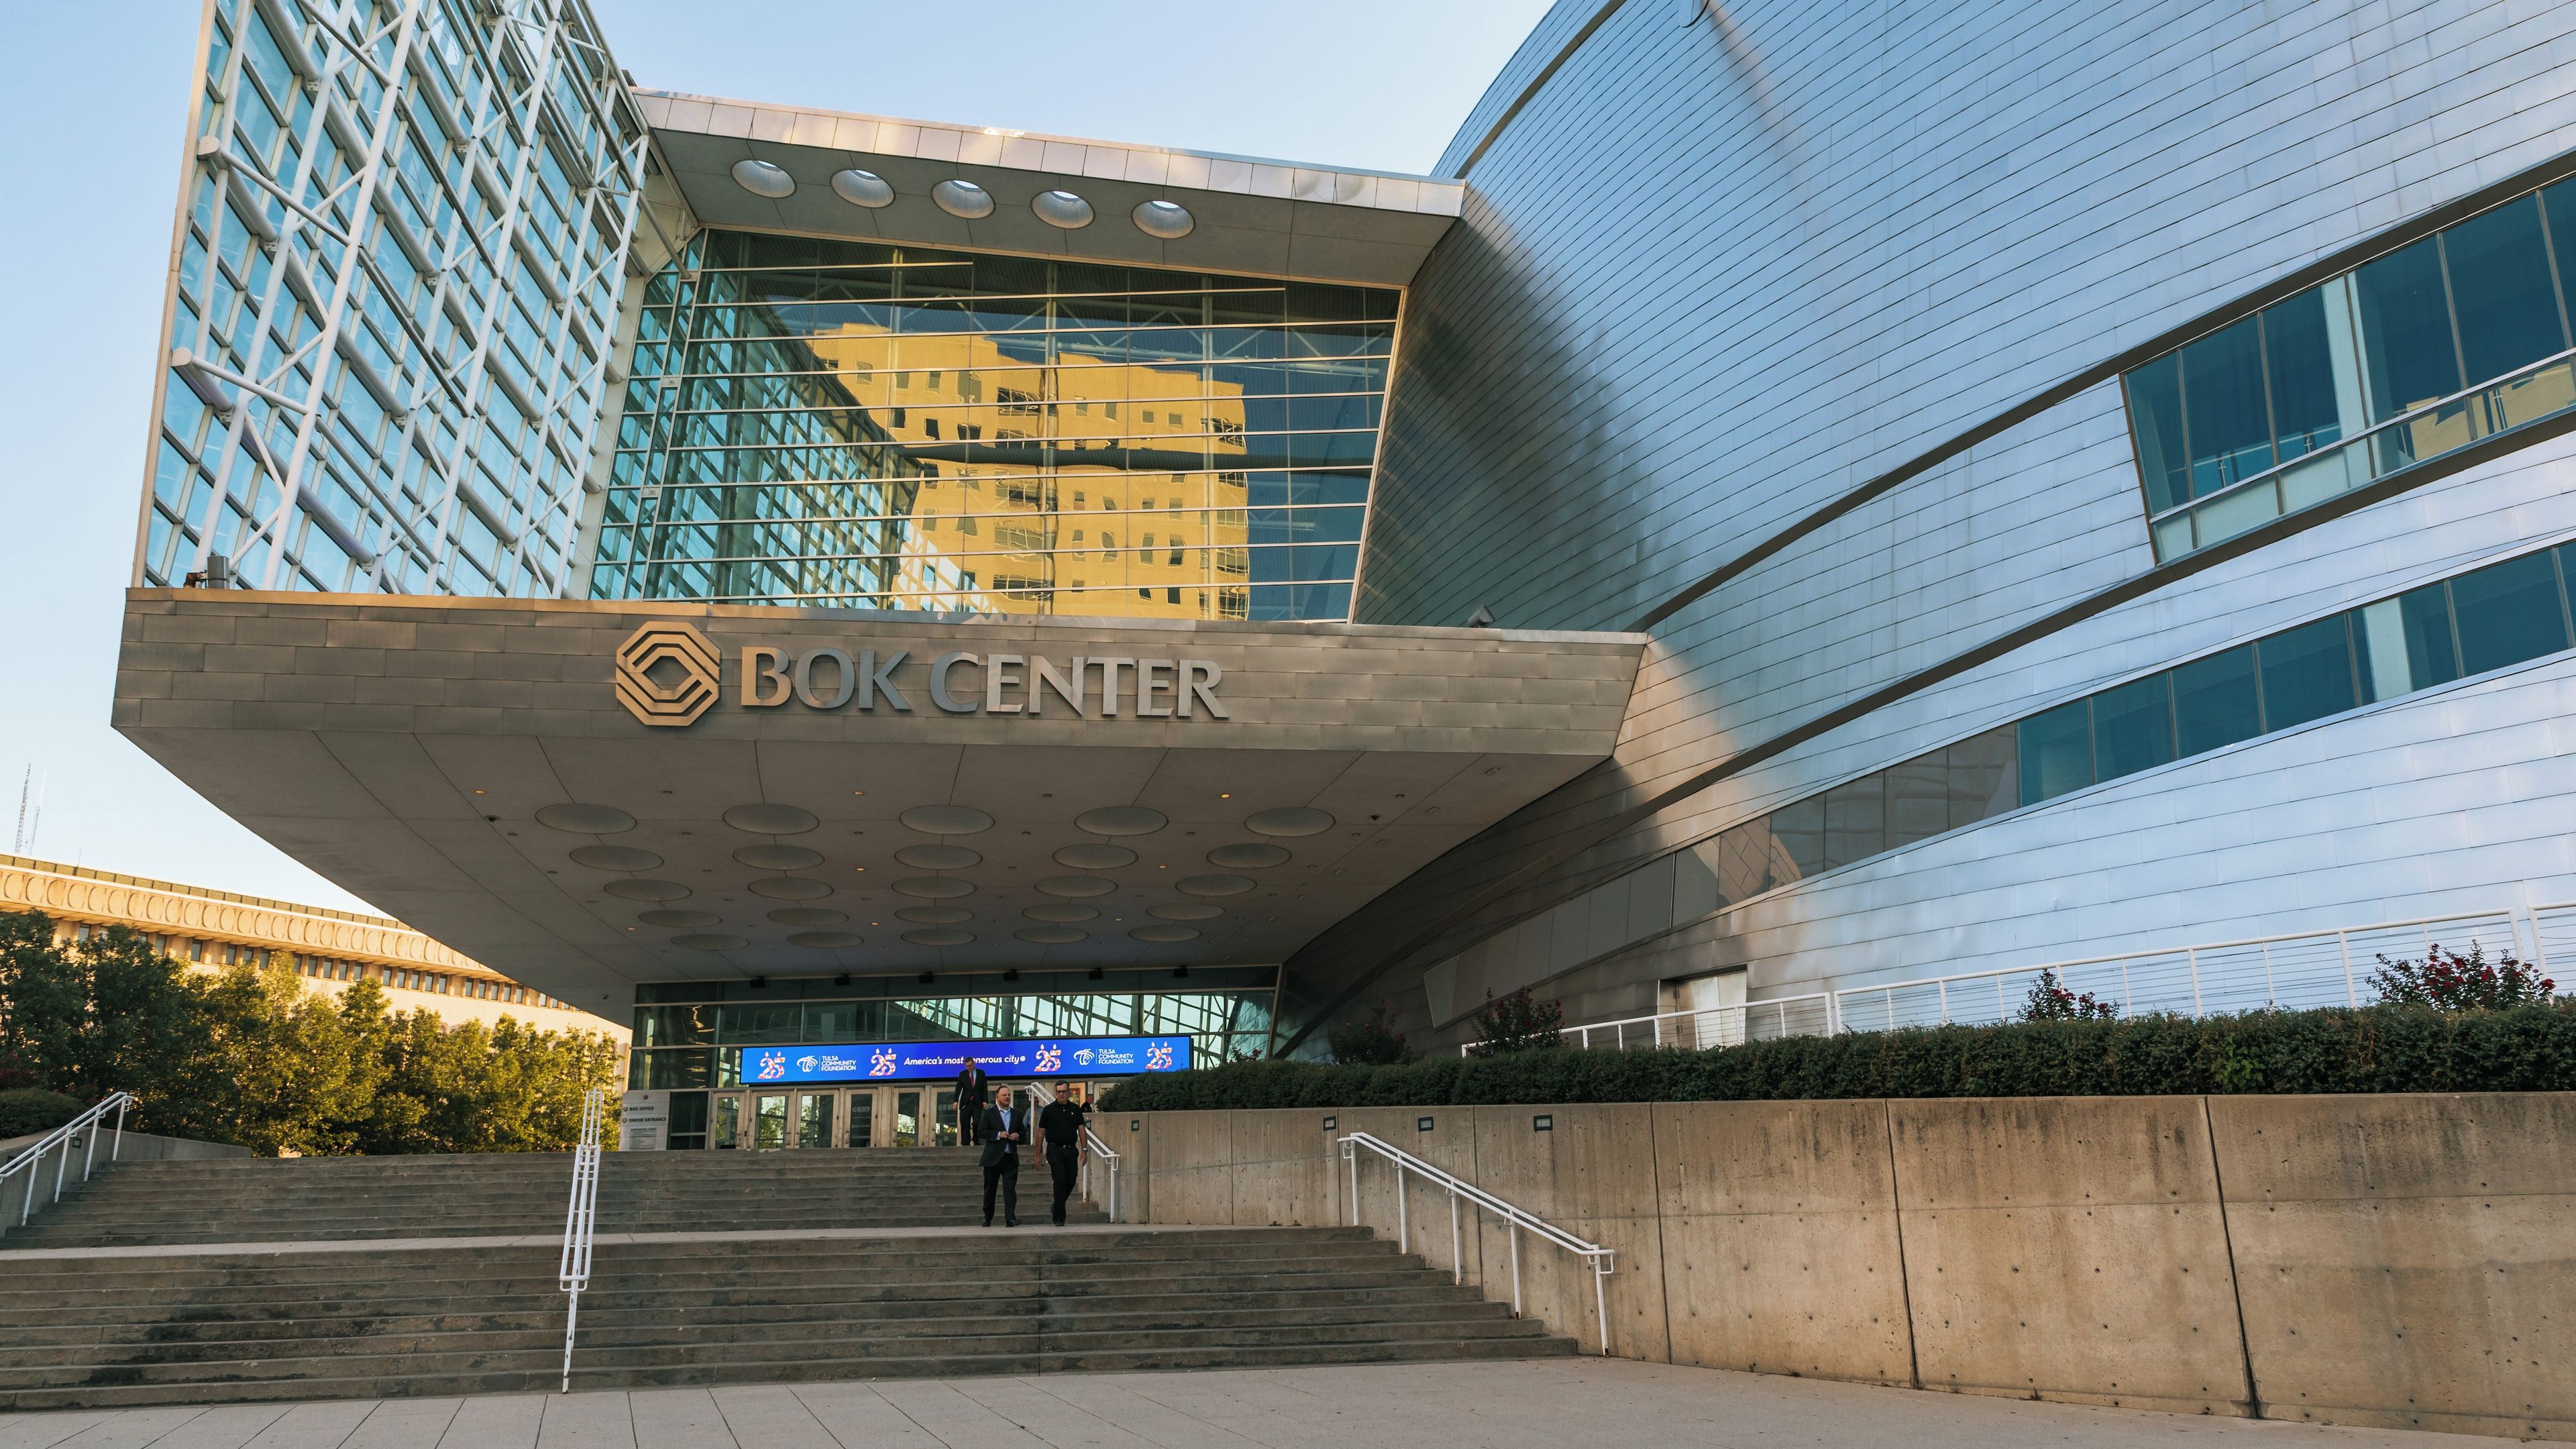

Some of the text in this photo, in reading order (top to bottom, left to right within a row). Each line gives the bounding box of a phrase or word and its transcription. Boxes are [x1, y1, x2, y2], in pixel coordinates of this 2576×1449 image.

[741, 646, 1230, 719] BOK CENTER
[904, 1057, 943, 1065] America's
[945, 1056, 964, 1065] most
[973, 1055, 1002, 1063] enerous
